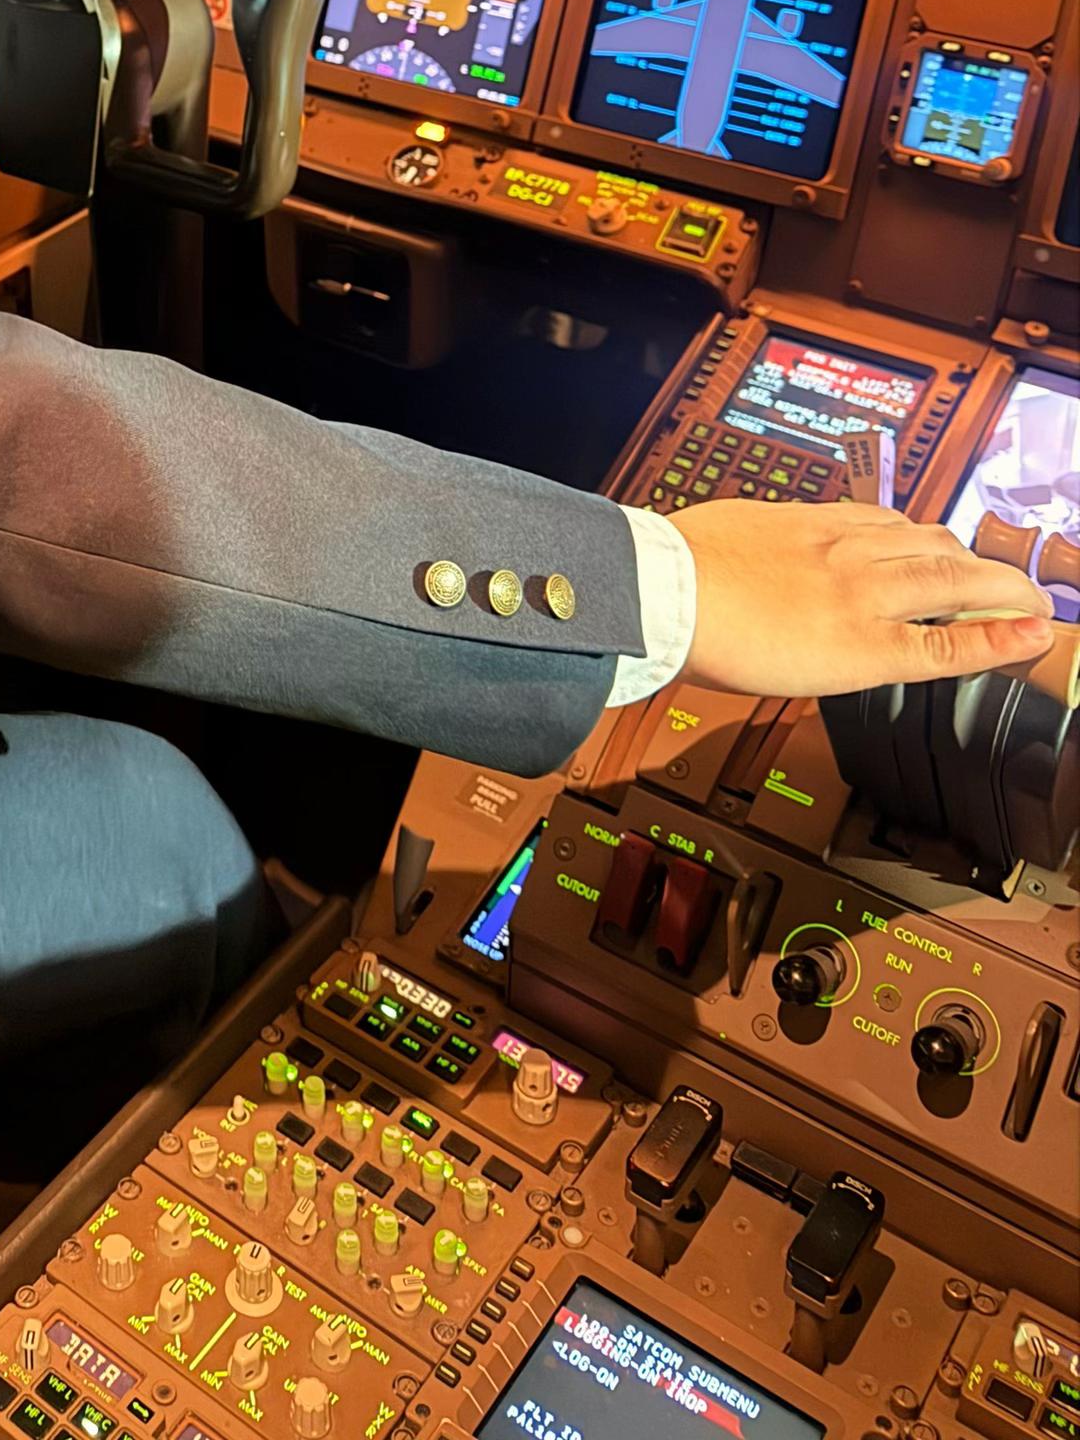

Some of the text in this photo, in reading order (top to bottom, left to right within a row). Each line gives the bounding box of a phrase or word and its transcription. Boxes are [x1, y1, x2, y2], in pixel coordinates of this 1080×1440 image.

[846, 440, 861, 479] BRAKE
[859, 439, 875, 477] SPEED
[666, 706, 701, 728] NOSE
[671, 719, 687, 731] UP
[768, 767, 787, 781] UP
[469, 792, 498, 814] PULL
[583, 822, 621, 848] NORM
[650, 824, 715, 863] C STAB R
[556, 873, 601, 902] CUTOUT
[835, 899, 983, 977] L FUEL CONTROL R
[885, 952, 913, 976] RUN
[852, 1015, 901, 1048] CUTOFF
[686, 1089, 711, 1108] DISCH
[845, 1175, 873, 1195] DISCH
[88, 1203, 119, 1235] WXR
[203, 1229, 229, 1250] MAN
[276, 1264, 287, 1277] R
[463, 1257, 488, 1277] SPKR
[189, 1272, 216, 1296] GAIN
[285, 1281, 308, 1302] TEST
[424, 1293, 448, 1315] MKR
[128, 1314, 150, 1335] MIN
[579, 1313, 638, 1358] LOG-ON
[262, 1324, 290, 1350] GAIN
[163, 1342, 189, 1365] MAX
[363, 1341, 390, 1365] MAN
[8, 1362, 33, 1386] SENS
[552, 1339, 620, 1393] <LOG-ON
[563, 1316, 708, 1415] LOGGING-ON INOP
[623, 1324, 761, 1419] SATCOM SUBMENU
[48, 1374, 66, 1394] VHF
[200, 1368, 223, 1391] MIN
[84, 1403, 104, 1423] VHF
[238, 1398, 263, 1422] MAX
[364, 1400, 397, 1439] WXR
[523, 1399, 555, 1427] FLT
